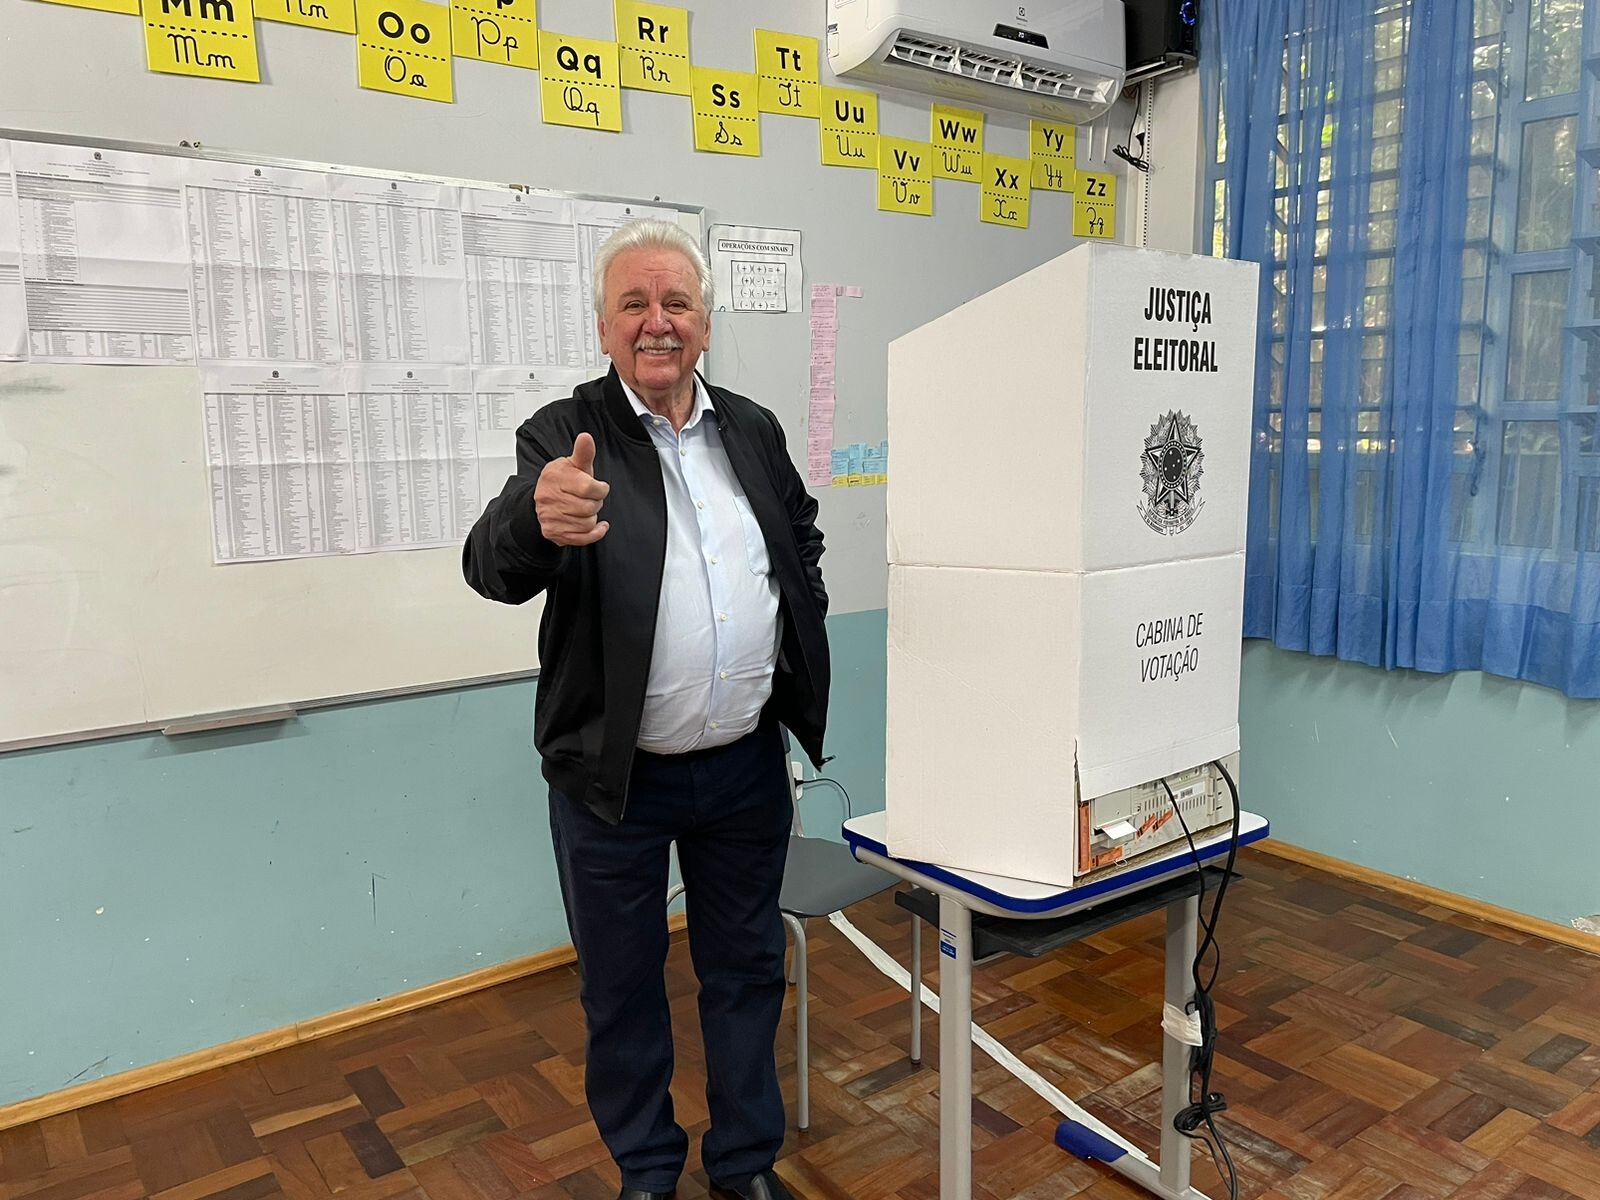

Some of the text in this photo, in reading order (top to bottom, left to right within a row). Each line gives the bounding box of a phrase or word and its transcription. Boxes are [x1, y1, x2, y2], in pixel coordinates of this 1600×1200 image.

[162, 0, 235, 22] Mm
[377, 12, 431, 44] Oo
[471, 17, 519, 61] Pp
[637, 17, 669, 43] Rr
[167, 34, 236, 70] Mm
[556, 46, 602, 80] Qq
[775, 47, 802, 71] Tt
[384, 55, 428, 88] Oo
[640, 56, 672, 83] Rr
[564, 86, 600, 127] Qq
[711, 84, 741, 109] Ss
[779, 83, 802, 107] Tt
[835, 100, 865, 123] Uu
[714, 121, 743, 146] Ss
[939, 119, 977, 143] Ww
[1042, 128, 1064, 152] Yy
[836, 135, 866, 158] Uu
[893, 150, 920, 172] Vv
[941, 152, 973, 176] Ww
[994, 168, 1019, 190] Xx
[1043, 164, 1063, 189] Yy
[1086, 178, 1106, 197] Zz
[892, 181, 921, 205] Vv
[992, 199, 1018, 221] Xx
[1086, 207, 1105, 235] Zz
[721, 242, 756, 251] OPERAÇÕES
[1145, 287, 1212, 333] JUSTIÇA
[1133, 337, 1219, 373] ELEITORAL
[1136, 612, 1204, 648] CABINA DE
[1140, 644, 1199, 682] VOTAÇÃO
